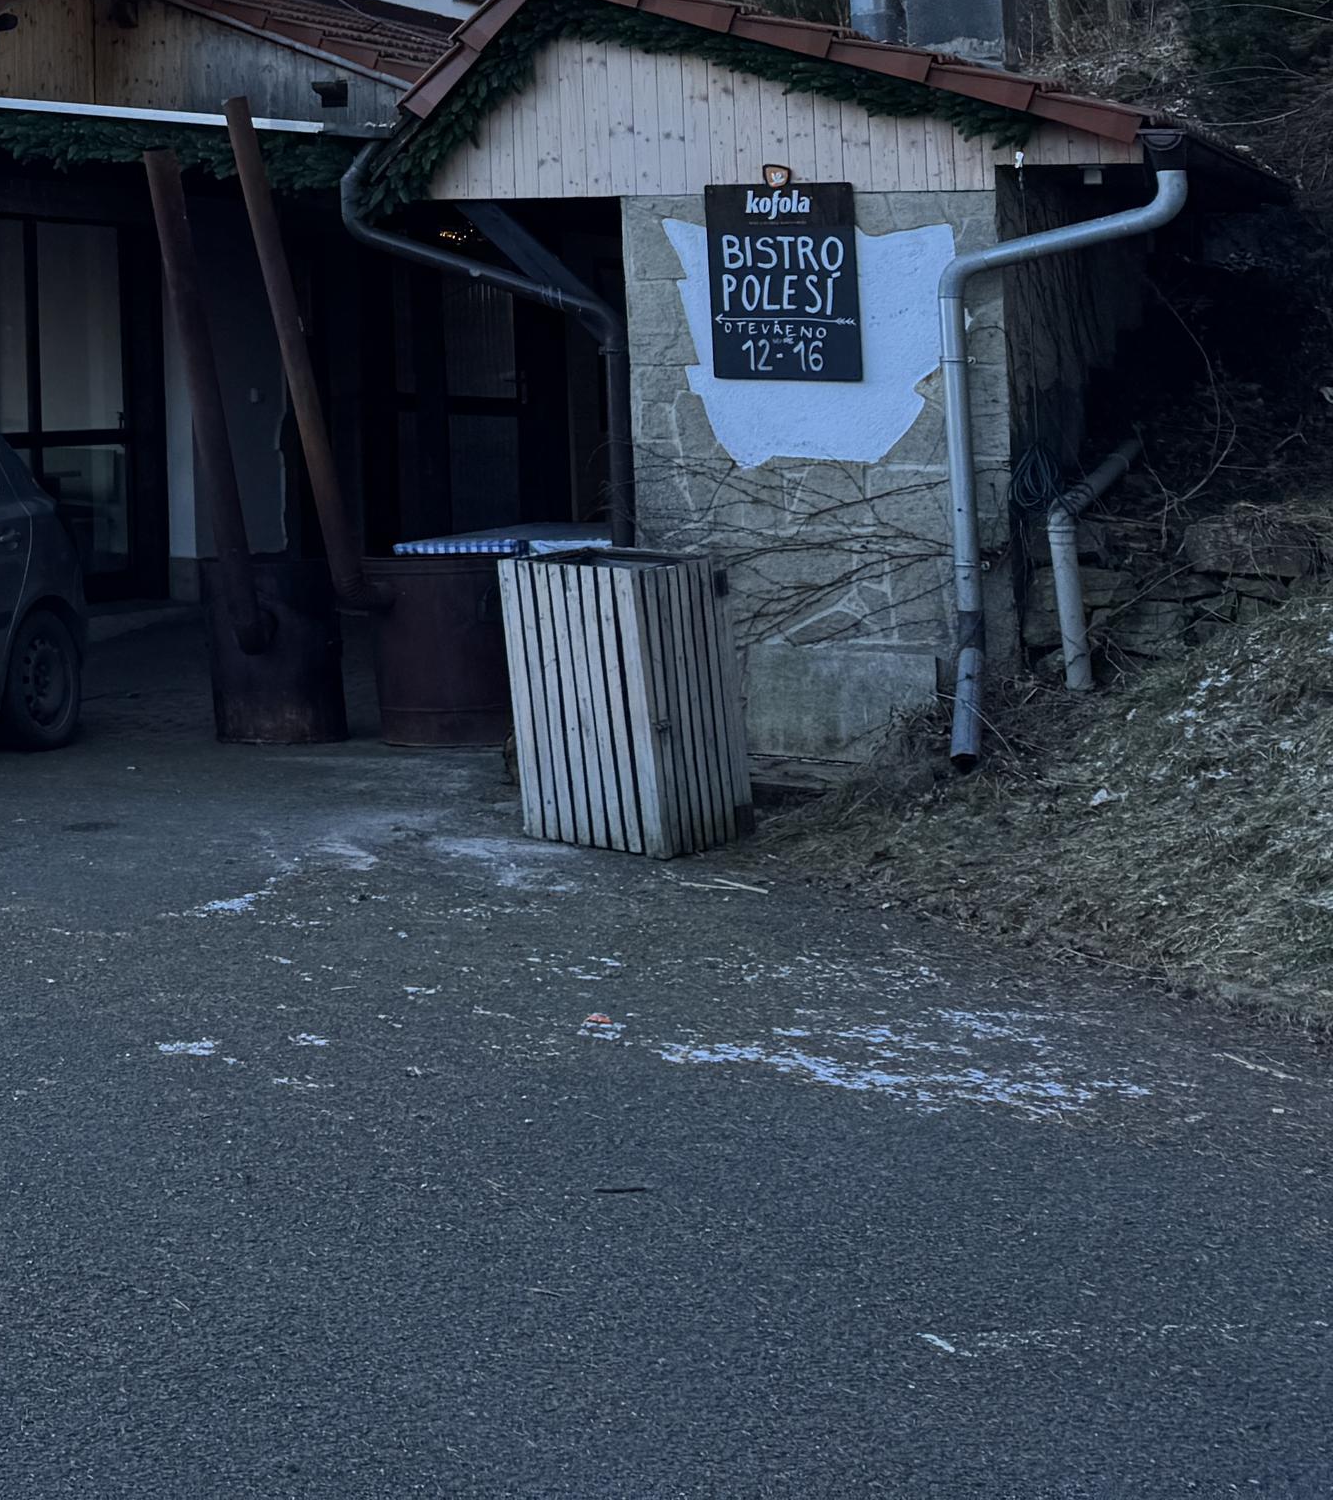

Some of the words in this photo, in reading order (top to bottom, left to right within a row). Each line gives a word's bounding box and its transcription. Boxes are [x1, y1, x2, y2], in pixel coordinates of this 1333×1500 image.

[745, 189, 811, 220] kofola
[722, 234, 844, 271] BISTRO
[722, 271, 842, 315] POLESÍ
[724, 320, 827, 339] OTEVŘENO
